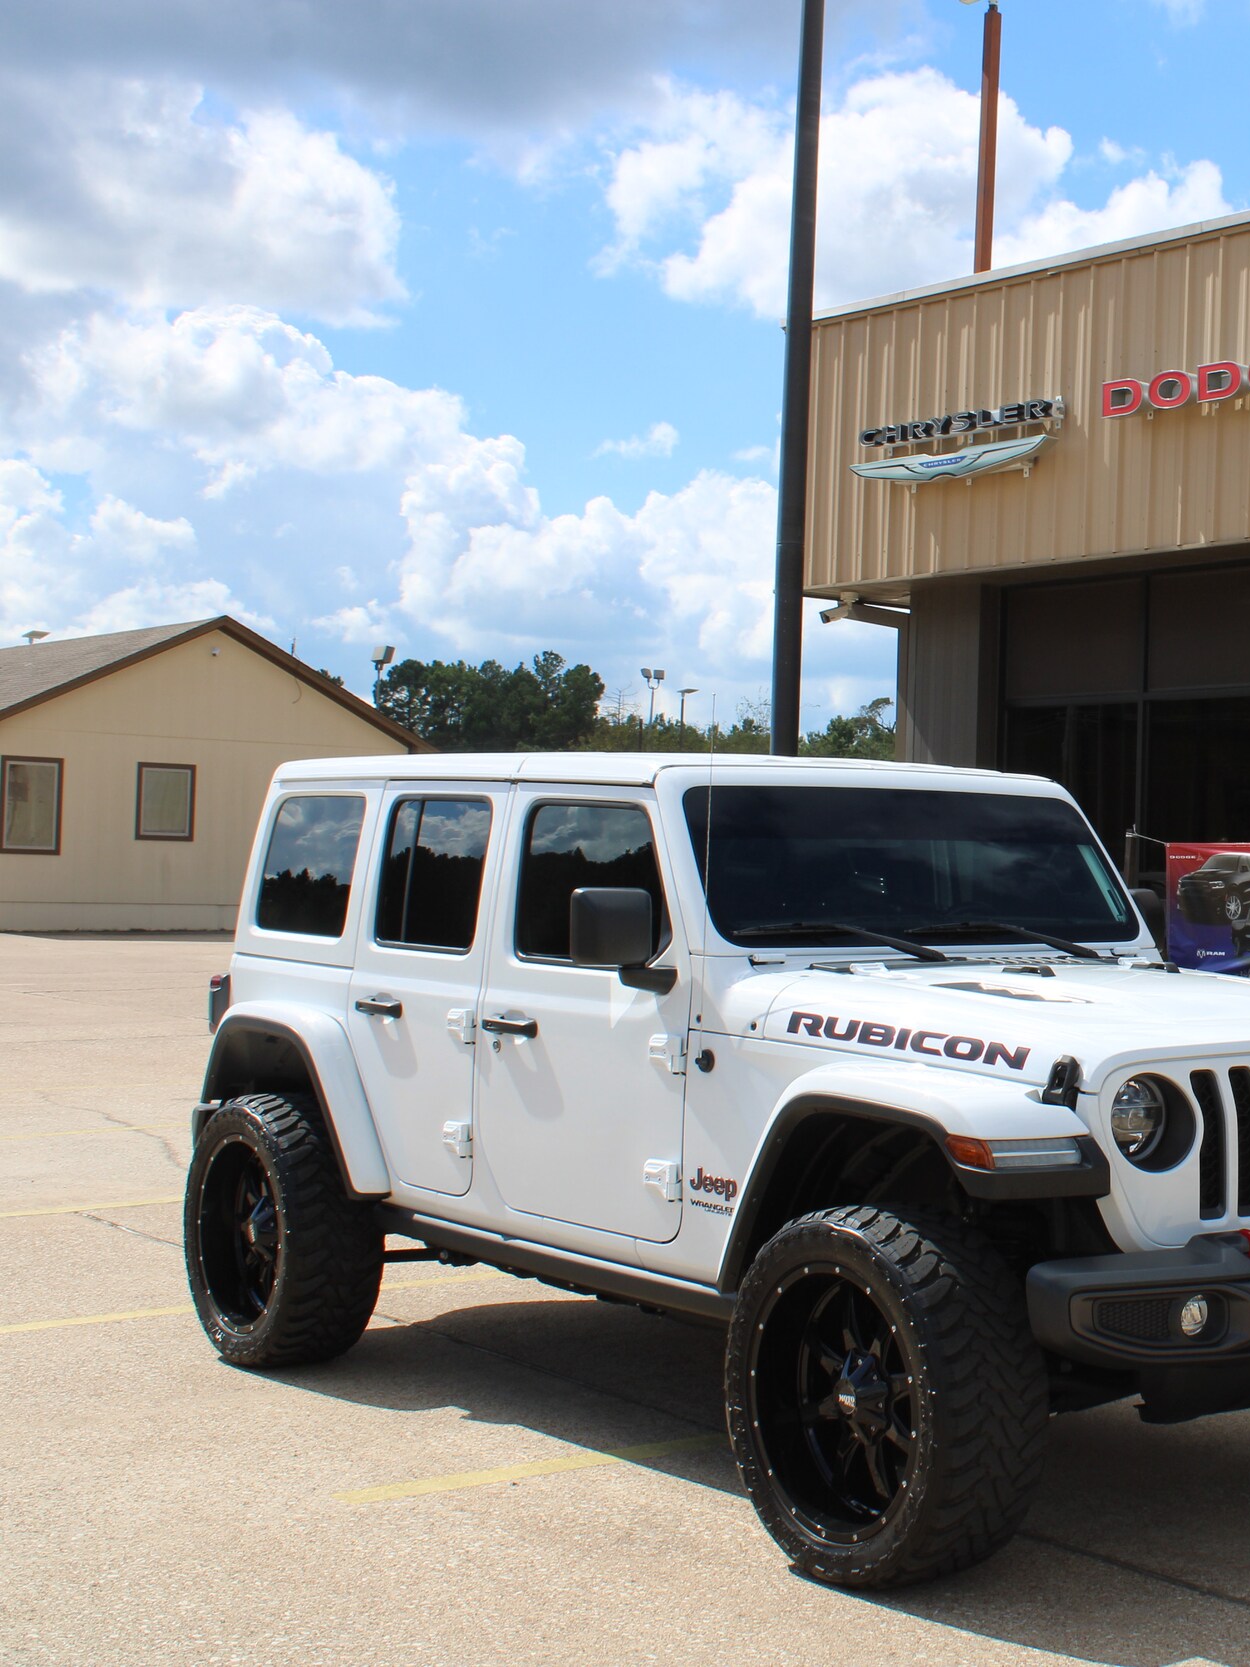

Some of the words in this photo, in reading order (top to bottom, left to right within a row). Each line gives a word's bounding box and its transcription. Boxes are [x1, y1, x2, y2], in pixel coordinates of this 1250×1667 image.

[859, 399, 1050, 447] CHRYSLER
[923, 458, 961, 467] CHRYSLER
[786, 1010, 1032, 1071] RUBICON
[689, 1166, 738, 1202] Jeep
